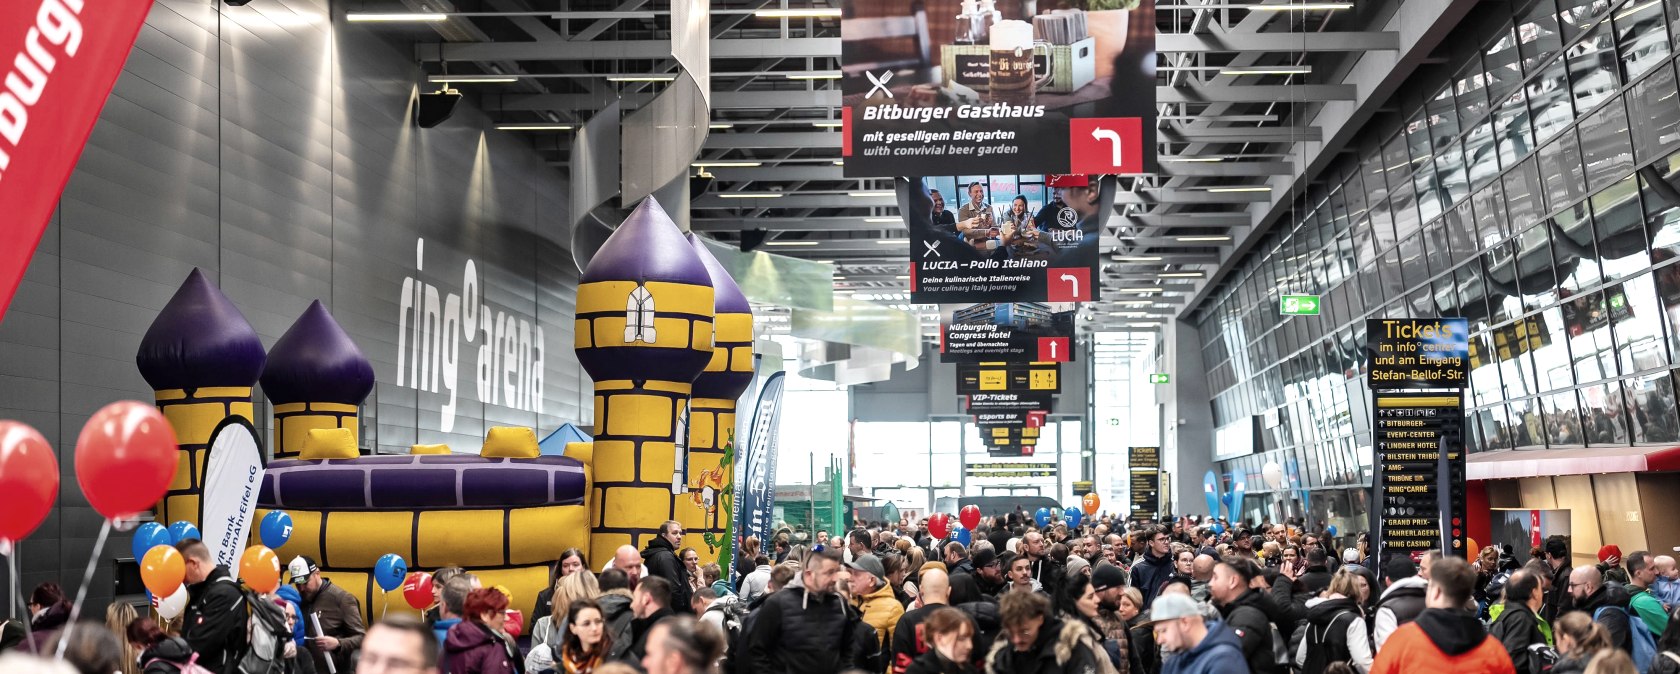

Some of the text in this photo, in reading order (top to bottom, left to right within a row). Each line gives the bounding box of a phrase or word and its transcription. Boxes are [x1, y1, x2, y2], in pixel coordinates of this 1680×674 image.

[863, 102, 1045, 123] Bitburger Gasthaus
[863, 129, 1015, 145] mit geselligem Biergarten
[863, 144, 1018, 156] with convivial beer garden
[1052, 229, 1083, 242] LUCIA
[922, 260, 958, 270] LUCIA
[970, 259, 999, 269] Pollo
[1001, 258, 1048, 269] Italiano
[944, 275, 988, 283] kulinarische
[989, 274, 1031, 282] Italienreise
[940, 284, 970, 293] culinary
[989, 284, 1017, 292] journey
[949, 323, 998, 332] Nürburgring
[1383, 320, 1452, 339] Tickets
[949, 331, 1011, 340] Congress Hotel
[1380, 341, 1393, 351] im
[1375, 355, 1461, 366] und am Eingang
[1372, 370, 1465, 380] Stefan-Bellof-Str.
[249, 465, 257, 483] eG
[1388, 474, 1413, 482] TRIBÜNE
[222, 515, 236, 547] Bank
[1388, 529, 1435, 537] FAHRERLAGER
